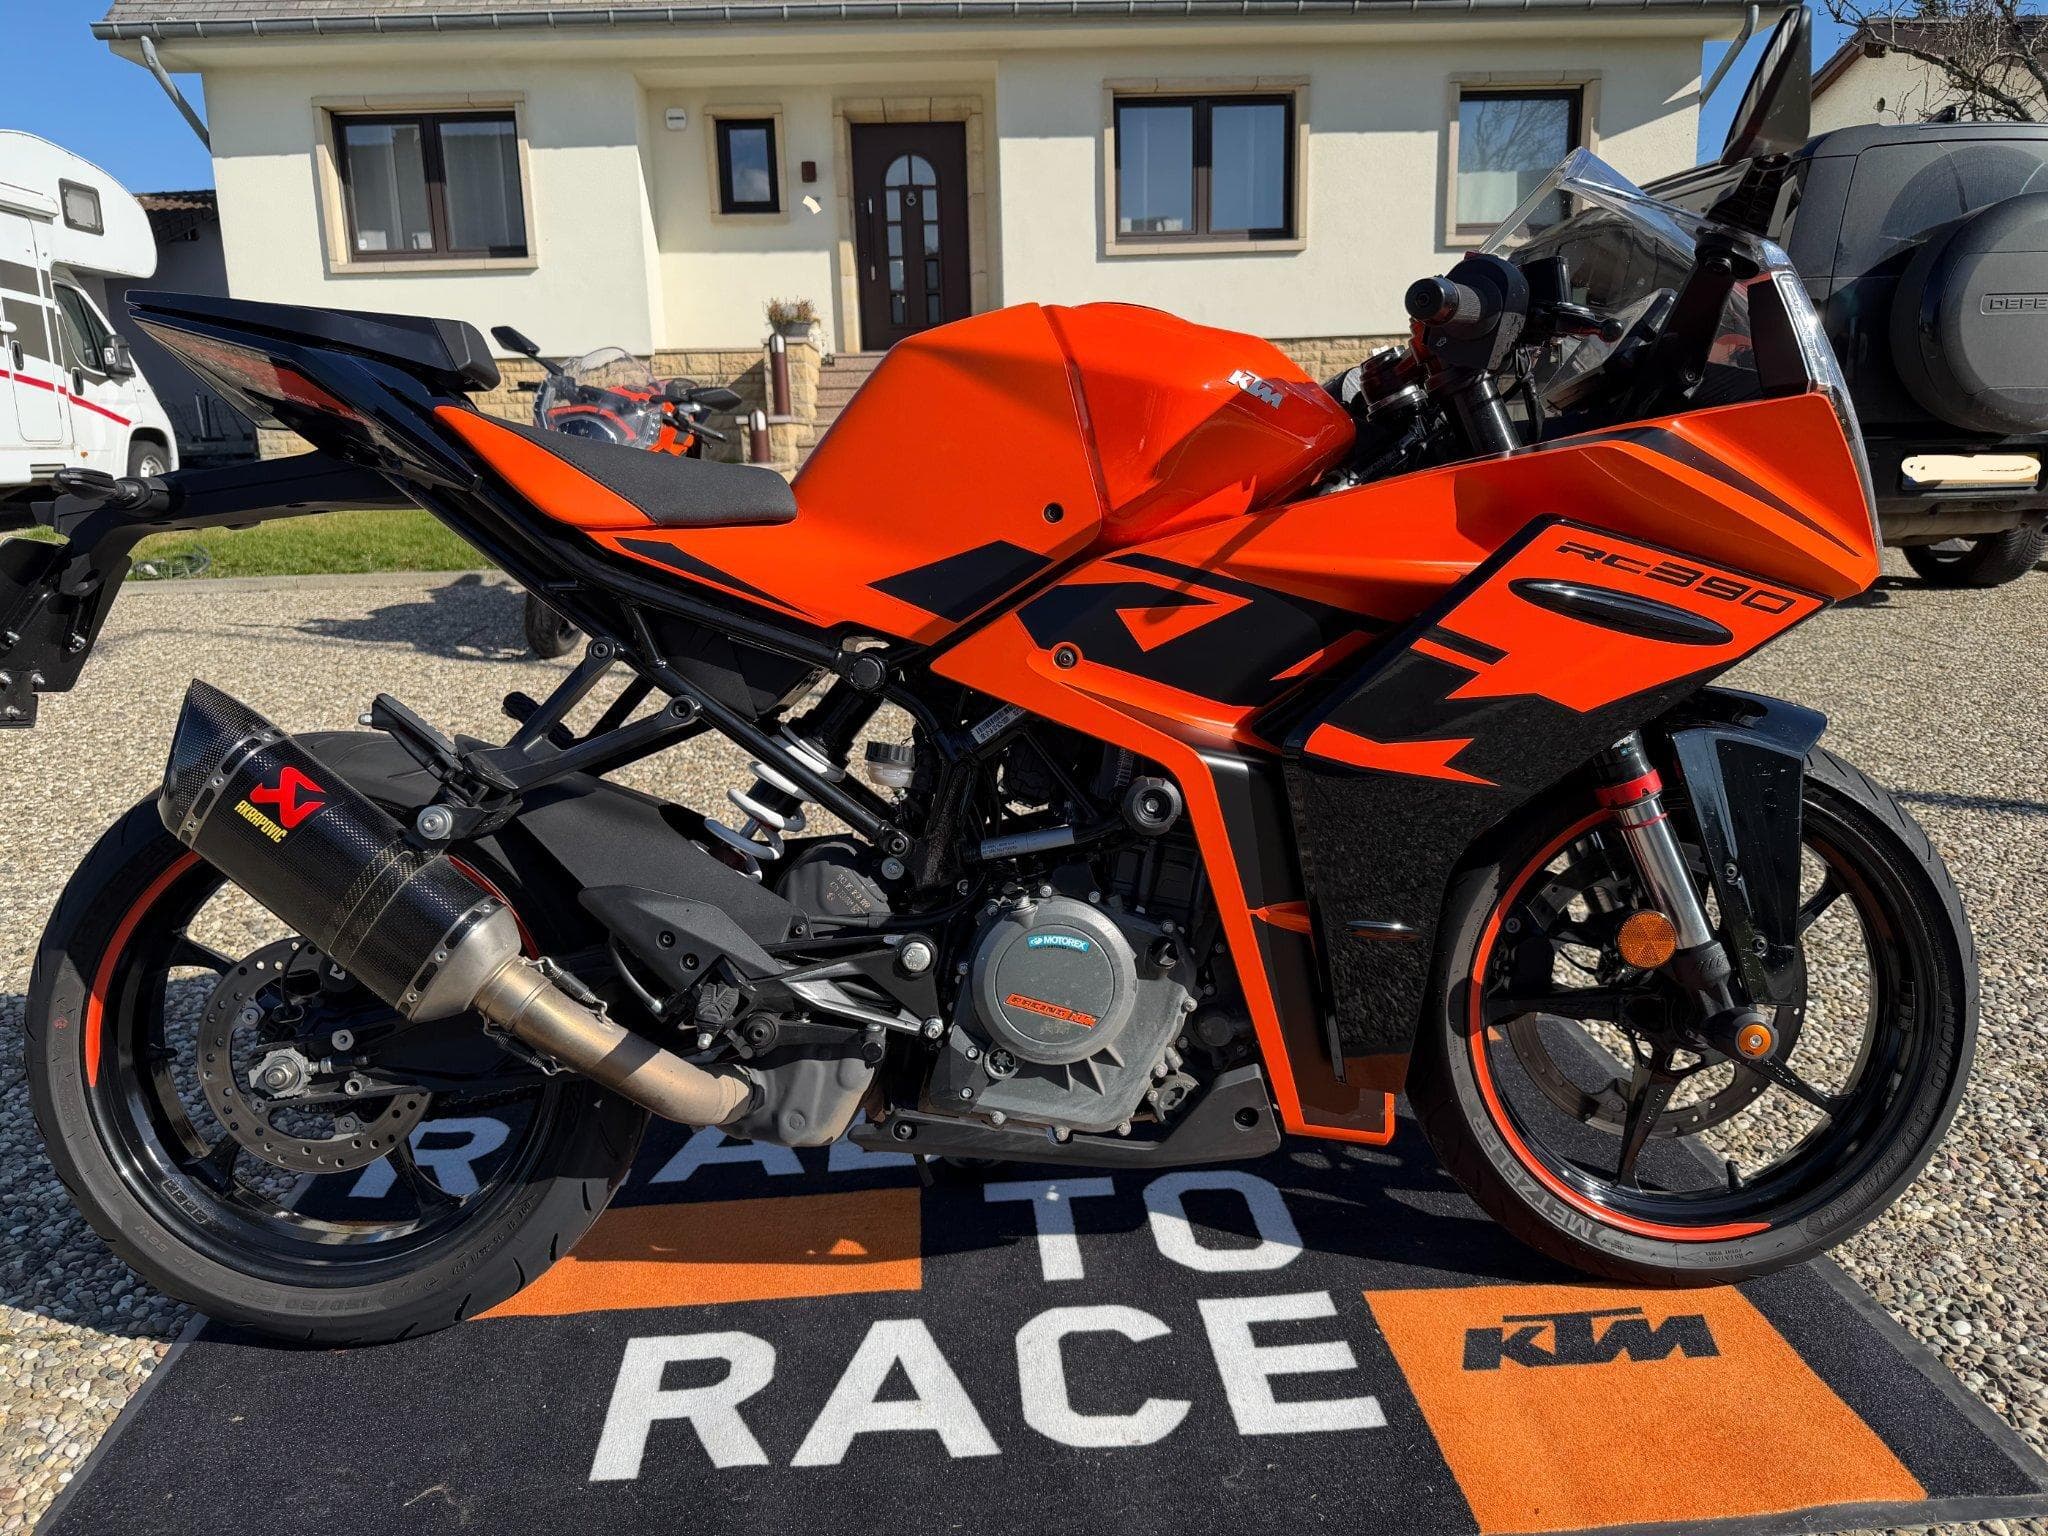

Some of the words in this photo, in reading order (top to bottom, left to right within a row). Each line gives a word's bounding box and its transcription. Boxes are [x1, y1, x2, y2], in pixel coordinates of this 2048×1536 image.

[1226, 369, 1283, 410] KTM
[1555, 541, 1798, 615] RC390
[1043, 935, 1086, 950] MOTOREX
[1471, 1116, 1594, 1240] METZELER
[983, 1169, 1304, 1282] TO
[1462, 1306, 1721, 1371] KTM
[588, 1290, 1388, 1481] RACE
